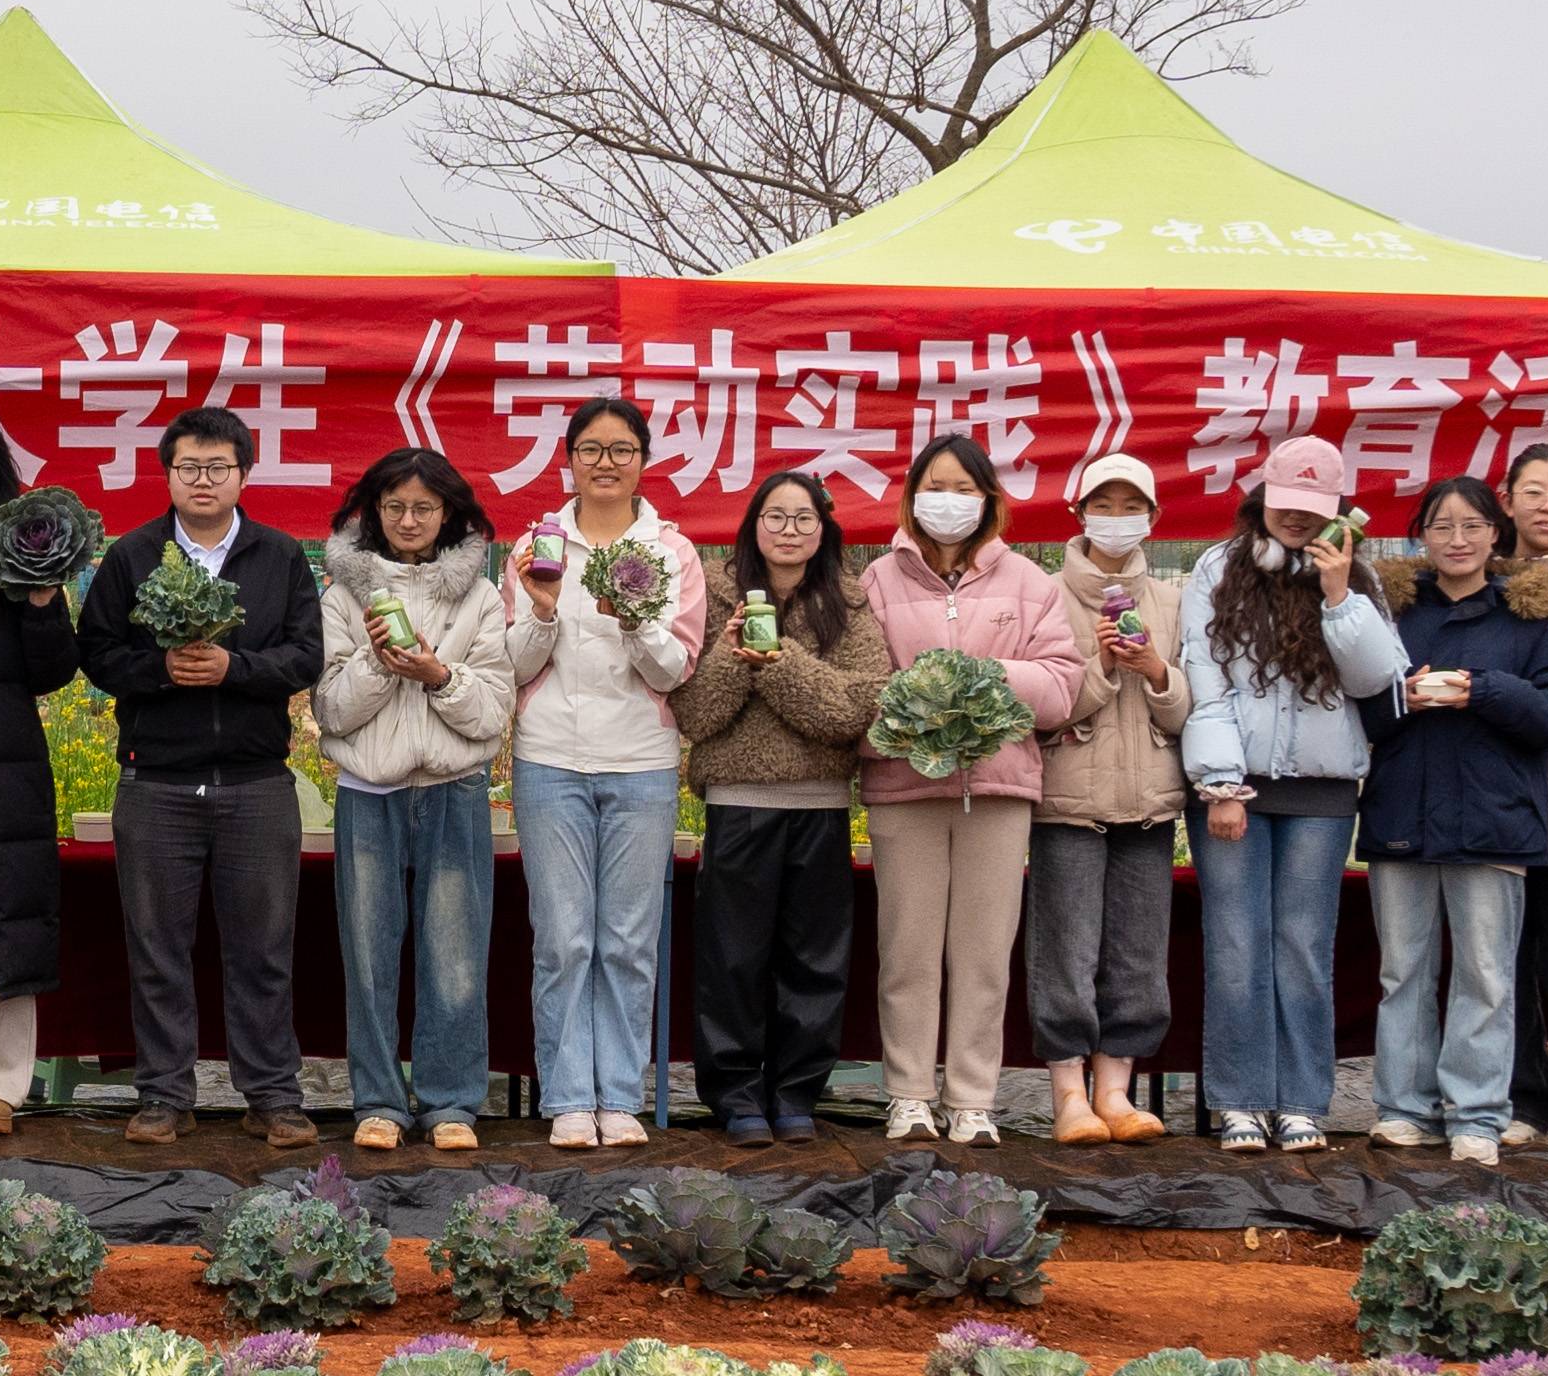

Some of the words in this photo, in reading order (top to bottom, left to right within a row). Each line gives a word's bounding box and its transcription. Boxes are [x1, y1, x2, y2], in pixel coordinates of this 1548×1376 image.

[69, 219, 221, 231] TELECOM
[1150, 218, 1414, 252] 中国电信
[1166, 244, 1268, 256] CHINA
[1274, 247, 1430, 263] TELECOM
